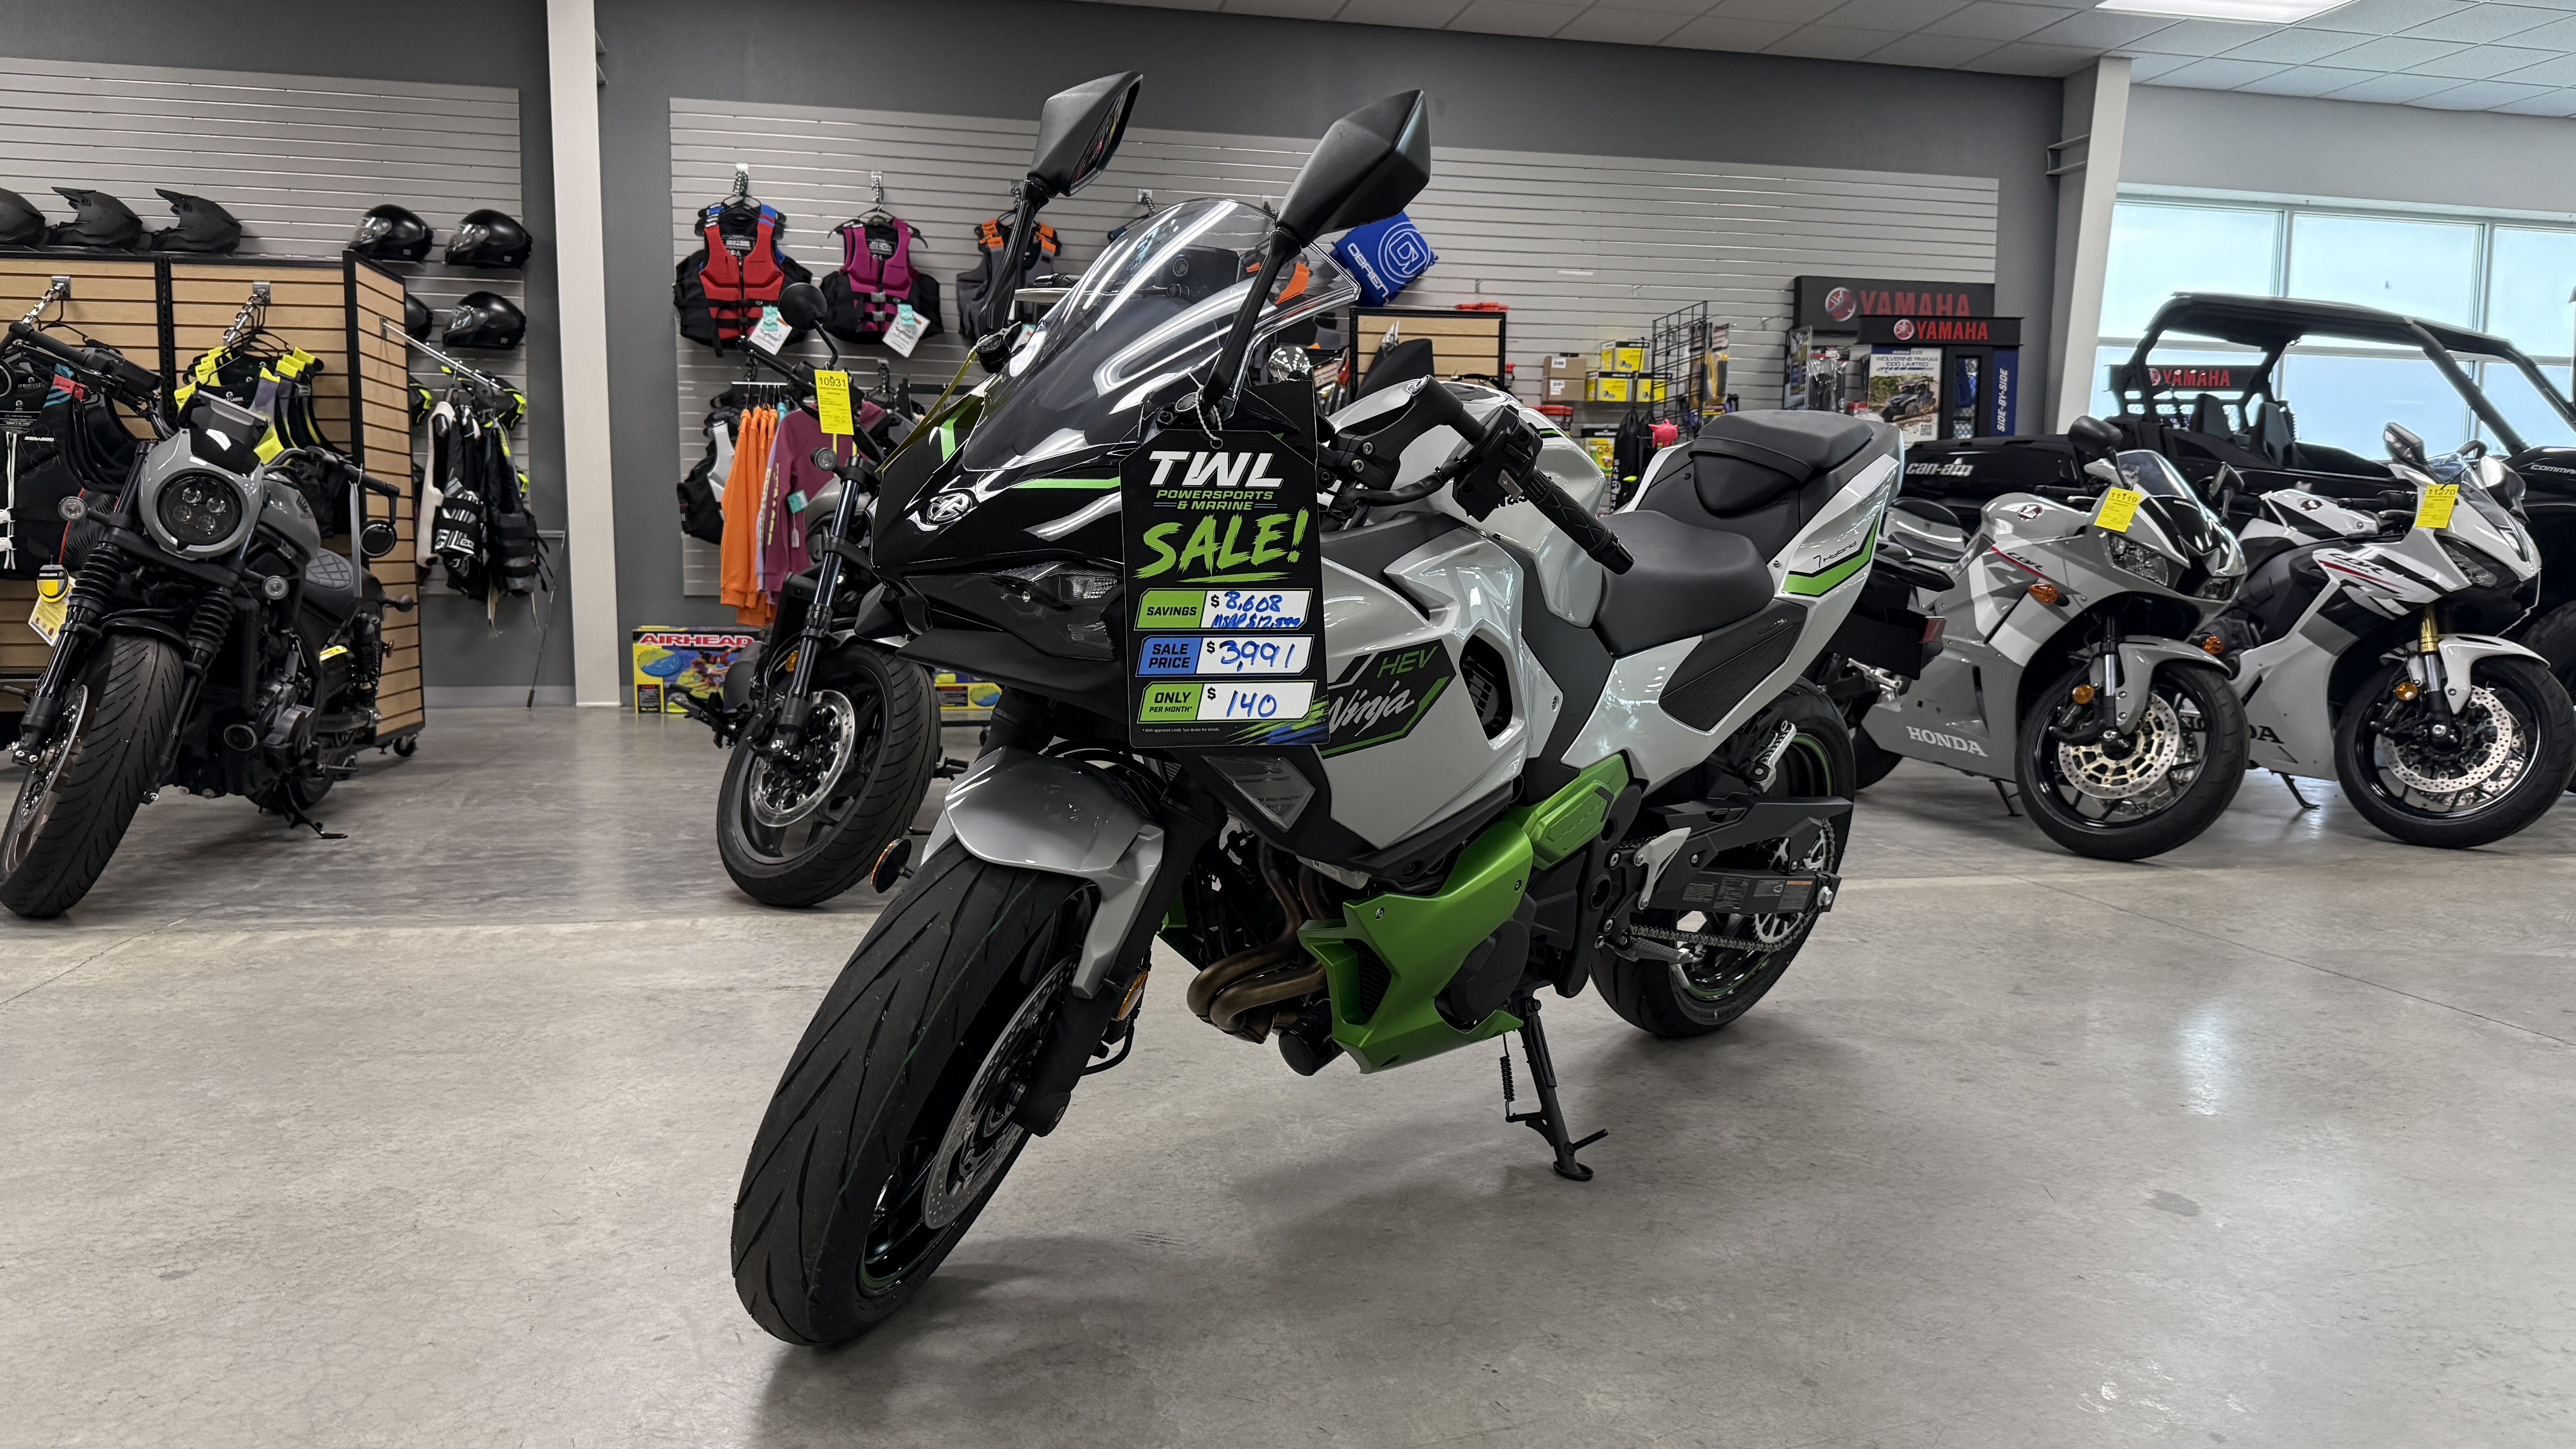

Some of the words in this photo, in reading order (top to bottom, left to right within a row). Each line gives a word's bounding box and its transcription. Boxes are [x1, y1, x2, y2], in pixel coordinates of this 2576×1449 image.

[1860, 290, 1970, 317] YAMAHA
[1916, 321, 1988, 340] YAMAHA
[819, 377, 846, 387] 10931
[2162, 369, 2230, 387] YAMAHA
[1996, 368, 2009, 432] SIDE-BY-SIDE
[1149, 451, 1284, 488] TWL
[1905, 460, 1975, 477] can-am
[2530, 464, 2576, 474] COMMA
[1156, 490, 1274, 500] POWERSPORTS
[1177, 501, 1187, 510] &
[1191, 501, 1254, 511] MARINE
[1132, 506, 1309, 579] SALE!
[1823, 540, 1857, 562] Hybrid
[2006, 552, 2043, 572] CBR
[2328, 553, 2383, 576] CBR
[1146, 606, 1197, 616] SAVINGS
[1152, 643, 1187, 655] SALE
[1149, 657, 1191, 669] PRICE
[1377, 646, 1439, 678] HEV
[1154, 692, 1191, 704] ONLY
[1329, 680, 1415, 737] Ninja
[1905, 726, 1988, 757] HONDA
